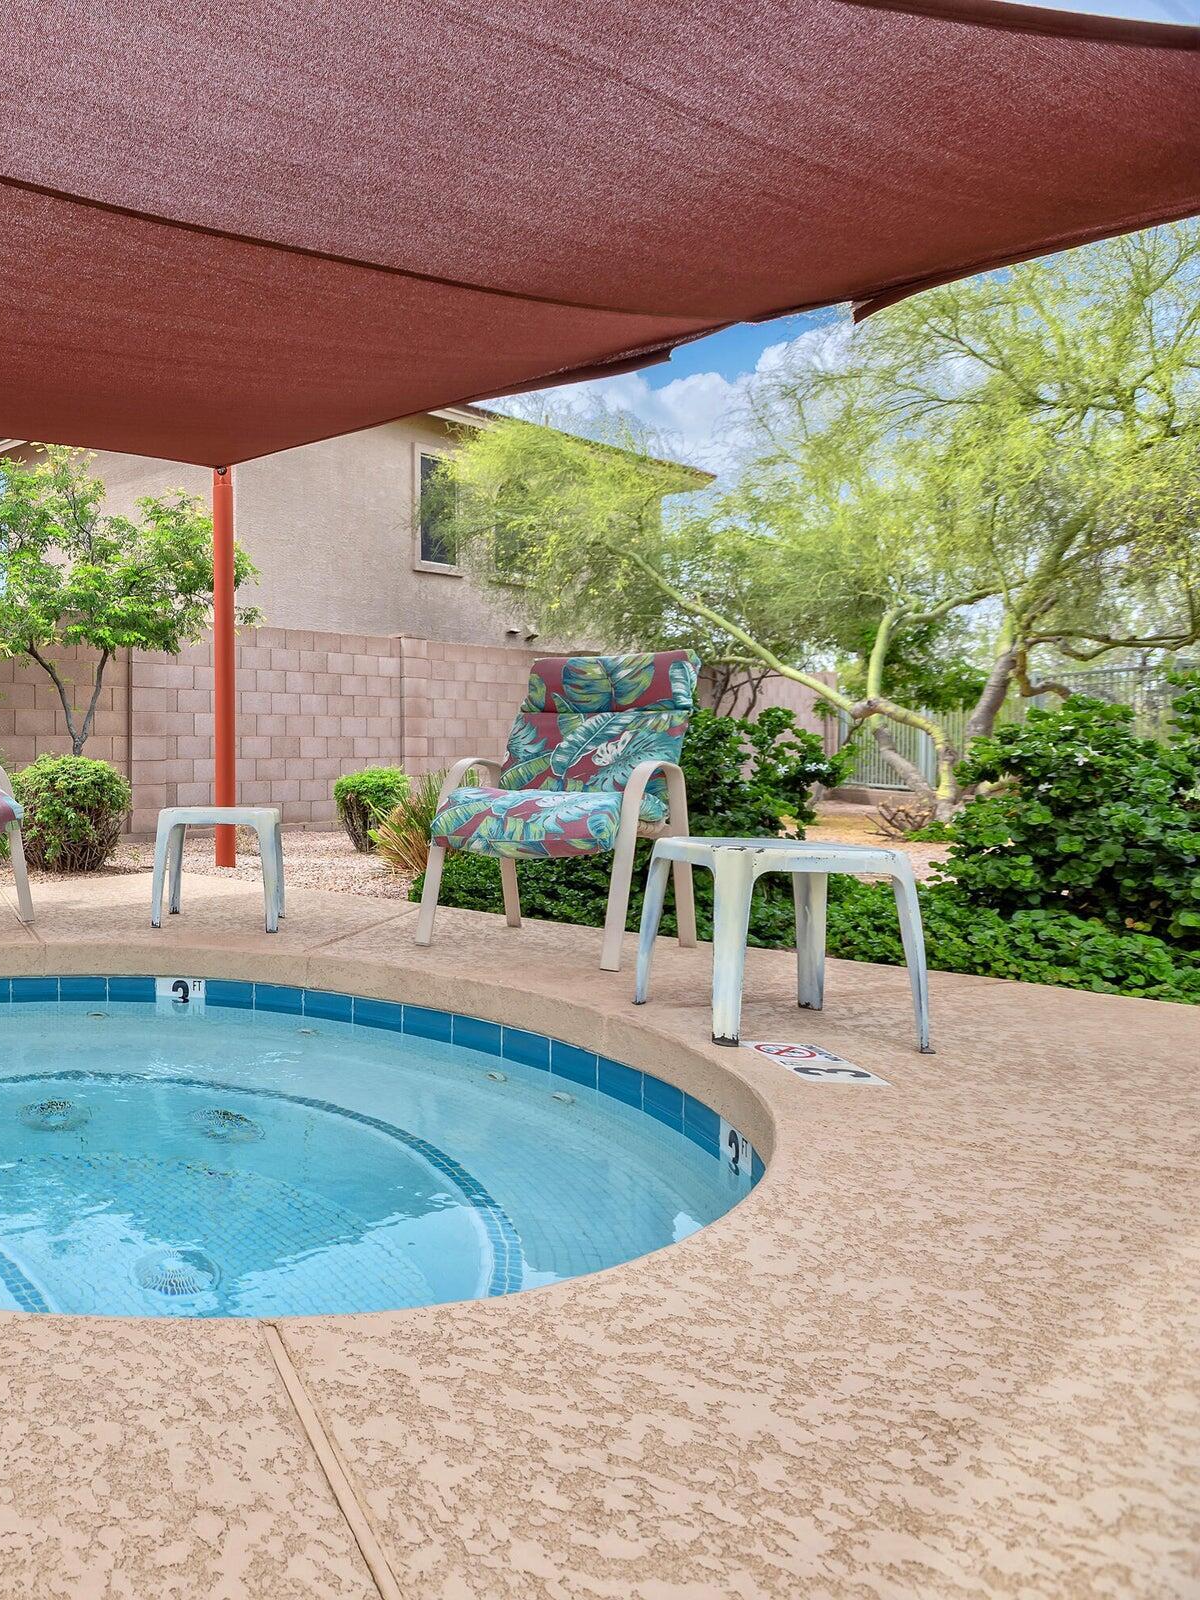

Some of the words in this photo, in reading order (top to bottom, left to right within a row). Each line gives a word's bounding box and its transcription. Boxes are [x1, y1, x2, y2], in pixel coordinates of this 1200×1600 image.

[171, 979, 189, 1004] 3
[192, 980, 202, 992] FT
[793, 1067, 871, 1078] 3
[741, 1137, 749, 1158] FT
